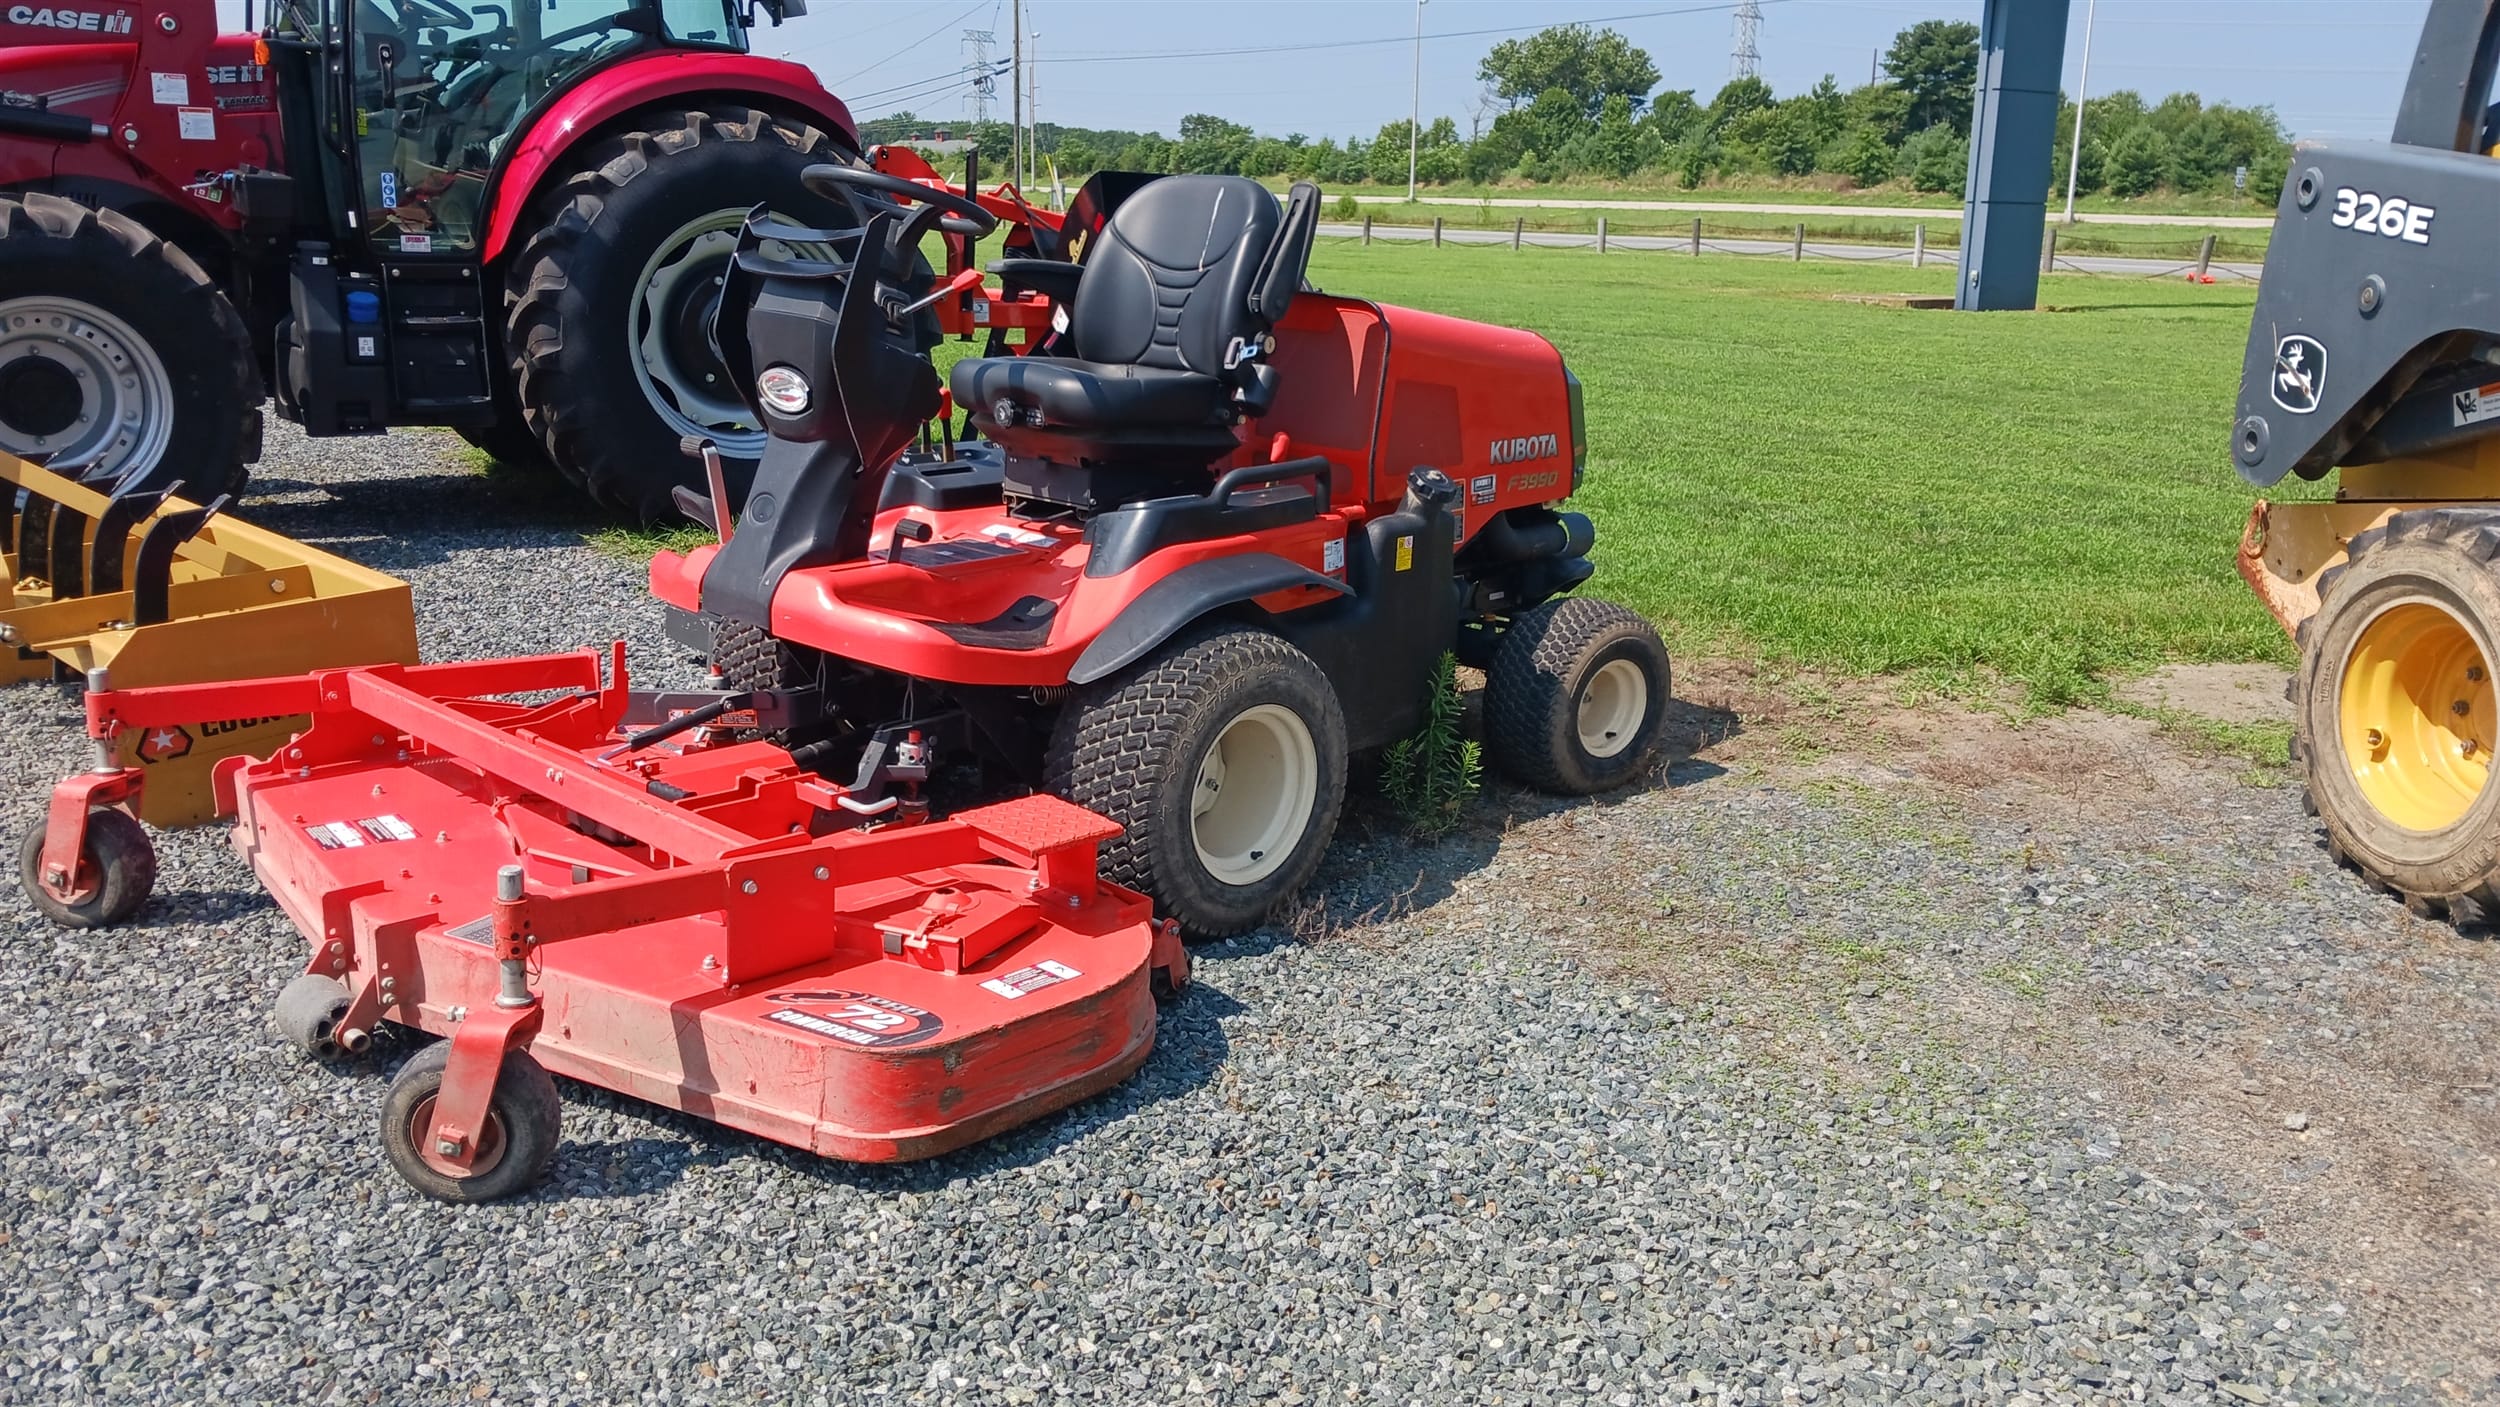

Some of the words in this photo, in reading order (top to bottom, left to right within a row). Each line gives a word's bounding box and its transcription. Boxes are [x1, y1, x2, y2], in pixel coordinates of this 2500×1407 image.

[8, 5, 101, 31] CASE
[104, 9, 133, 34] IH
[2331, 186, 2436, 246] 326E
[1490, 434, 1558, 465] KUBOTA
[1507, 471, 1559, 493] F3990
[769, 1010, 881, 1045] COMMERCIAL
[826, 1003, 906, 1031] 72
